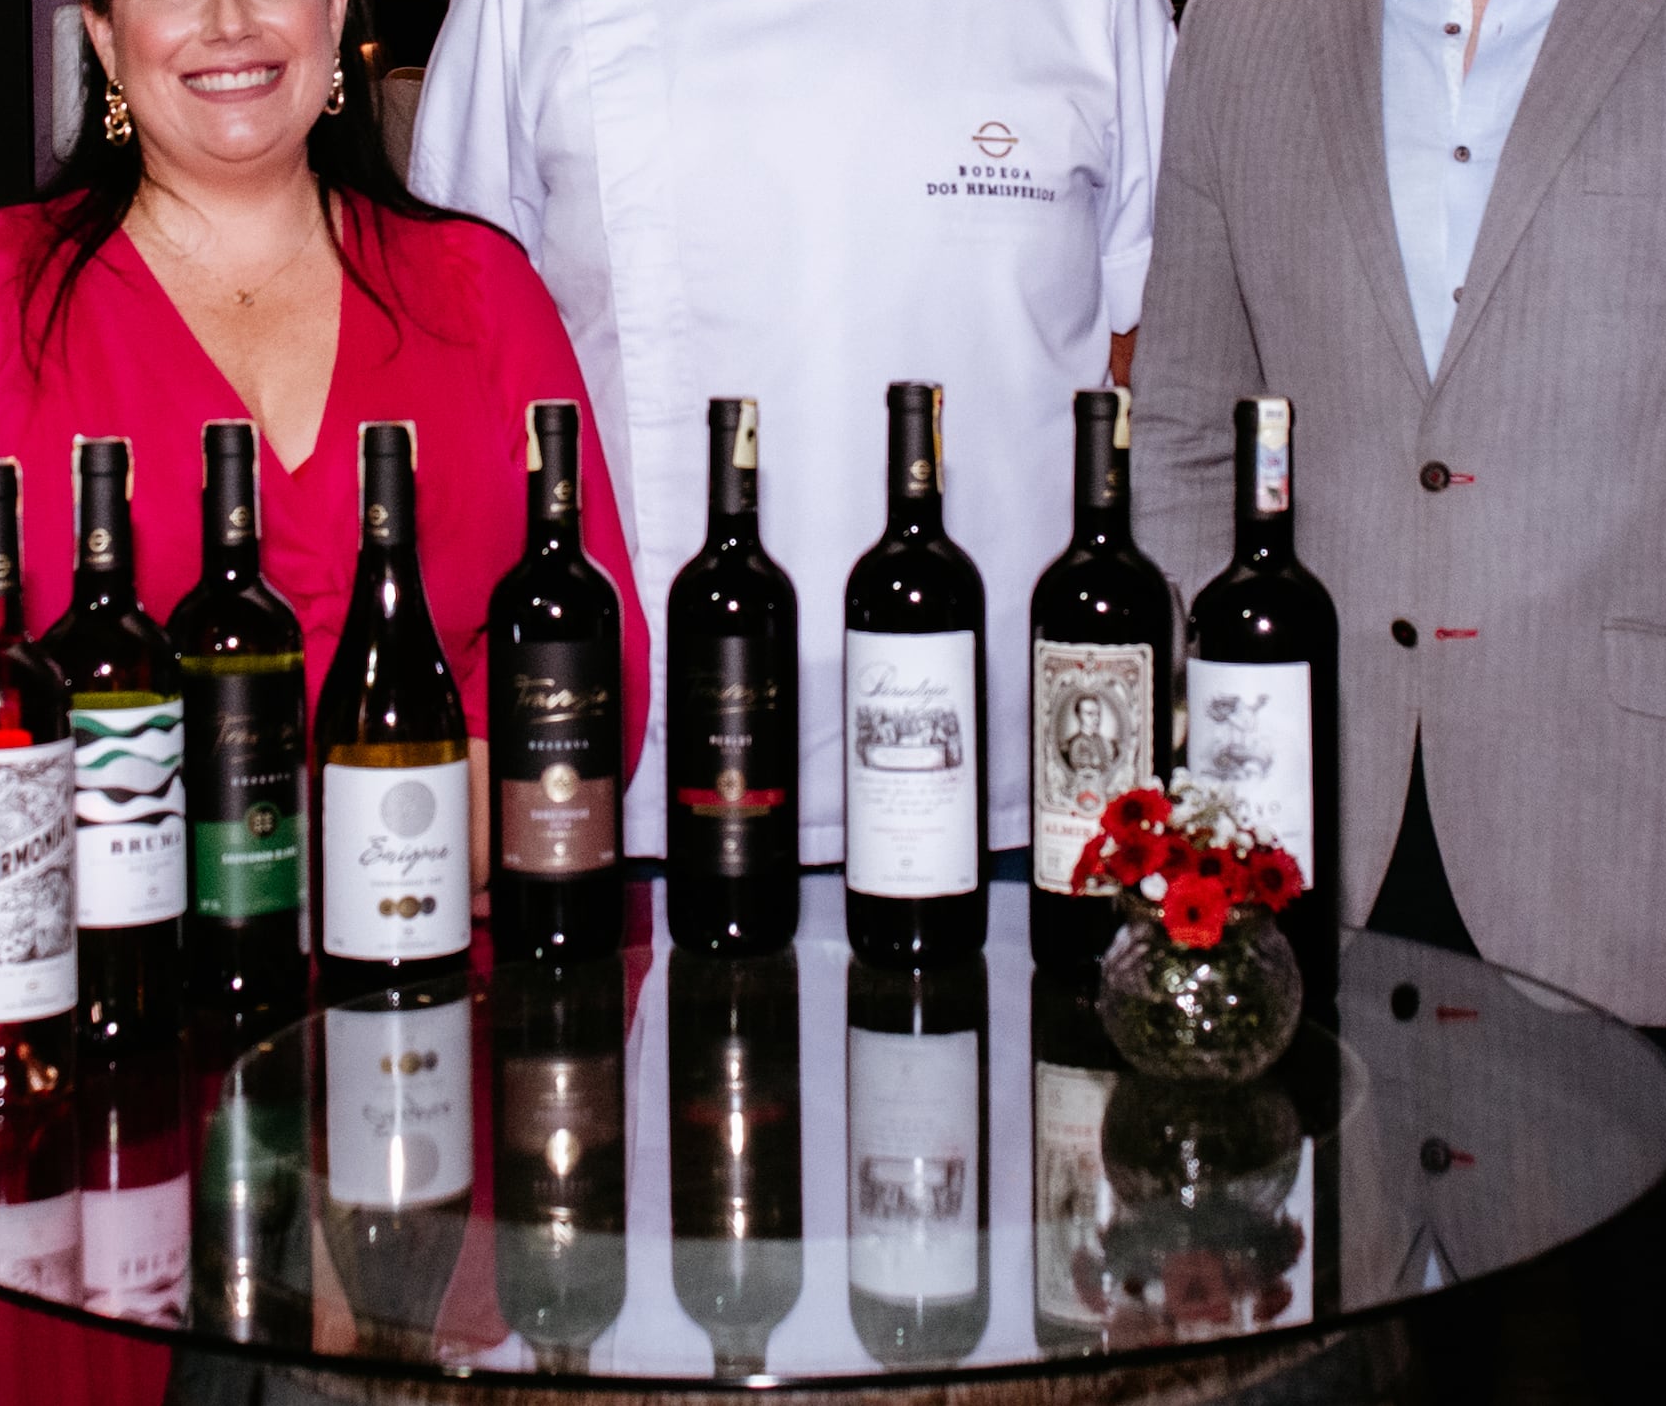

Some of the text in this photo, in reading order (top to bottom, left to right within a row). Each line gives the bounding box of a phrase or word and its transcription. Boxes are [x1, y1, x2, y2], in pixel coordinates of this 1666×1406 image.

[959, 165, 1031, 180] BODEGA
[927, 183, 1055, 202] DOS HEMISFERIOS
